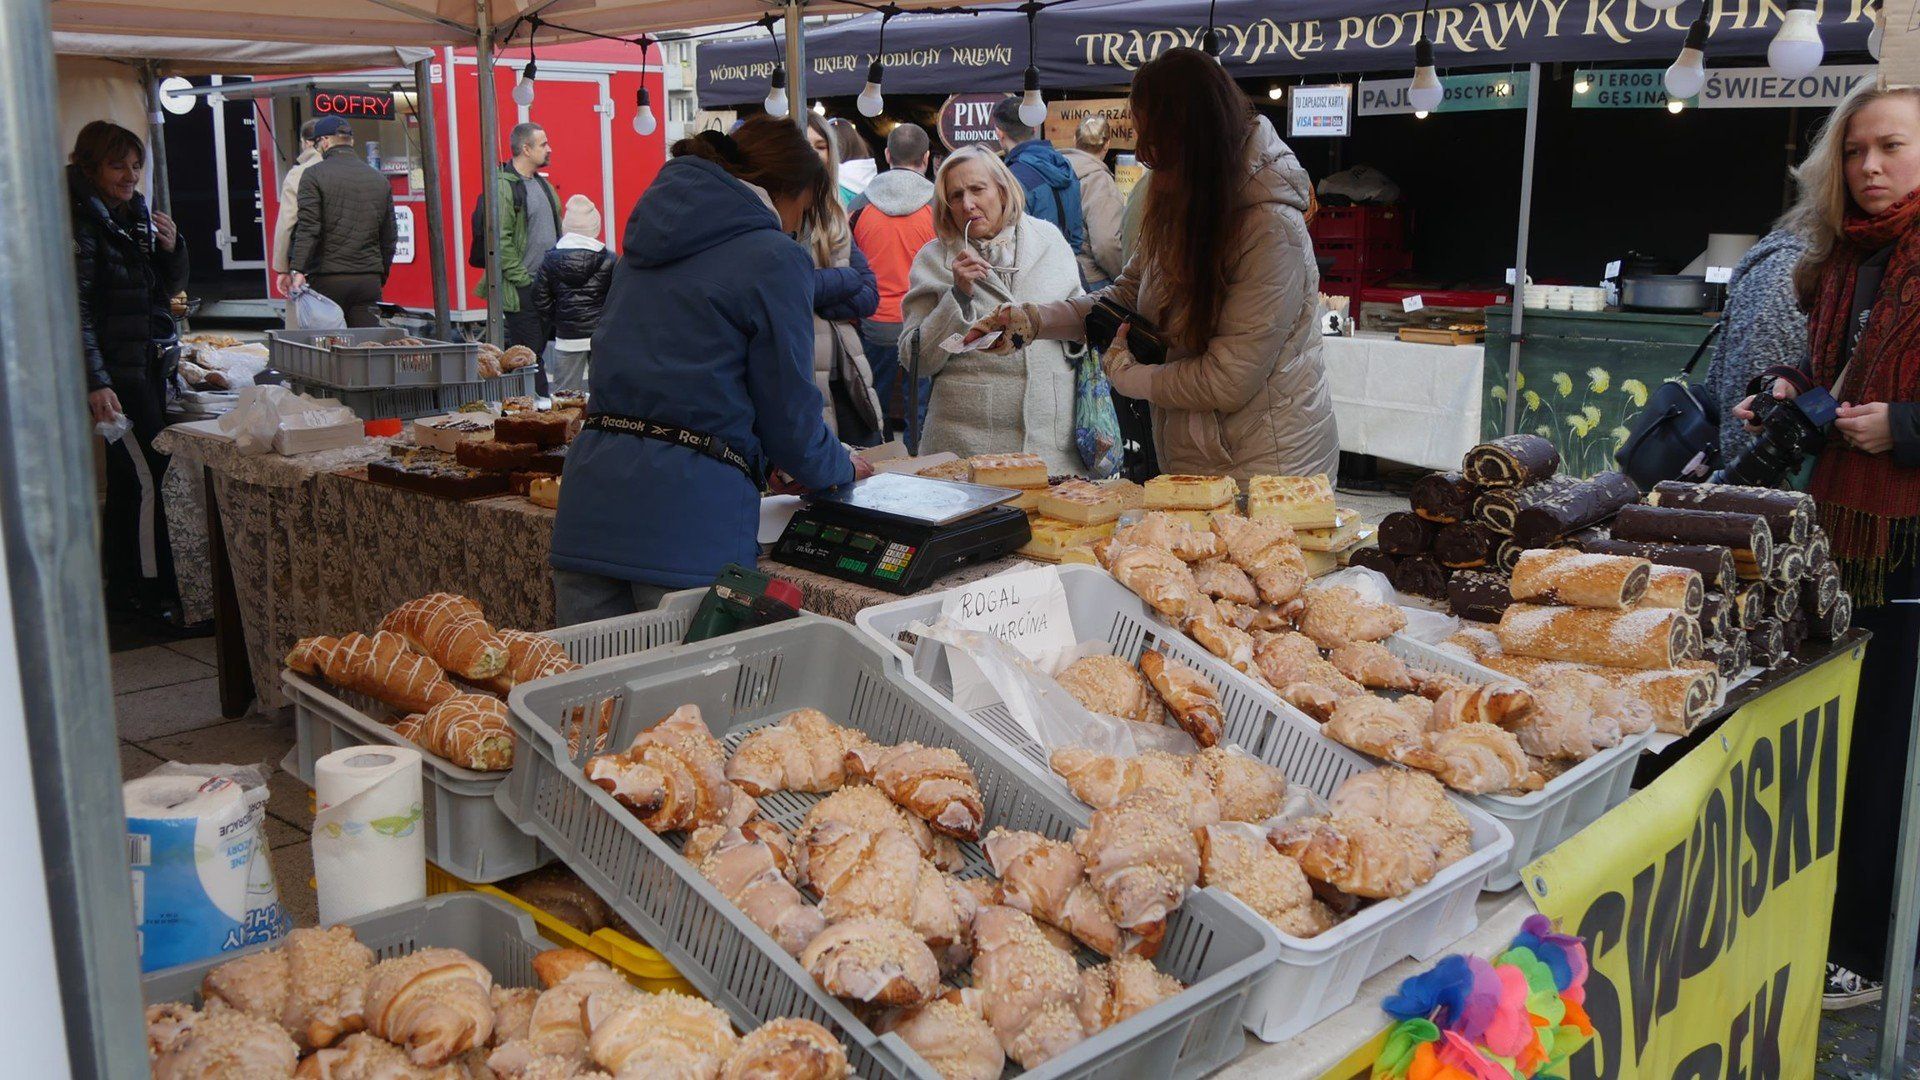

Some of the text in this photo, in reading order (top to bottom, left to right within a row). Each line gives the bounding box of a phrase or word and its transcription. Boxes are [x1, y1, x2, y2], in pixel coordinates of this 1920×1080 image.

[1333, 0, 1567, 52] POTRAWY
[813, 54, 858, 74] LIKIERY
[951, 43, 1012, 66] NALEWKI
[709, 63, 748, 84] WÓDKI
[1586, 72, 1662, 87] PIEROGI
[315, 93, 391, 115] GOFRY
[954, 101, 995, 126] PIW
[955, 130, 999, 141] BRODNICK
[601, 415, 646, 432] Reebok
[960, 585, 1020, 622] ROGAL
[1569, 695, 1841, 1080] SWOJSKI
